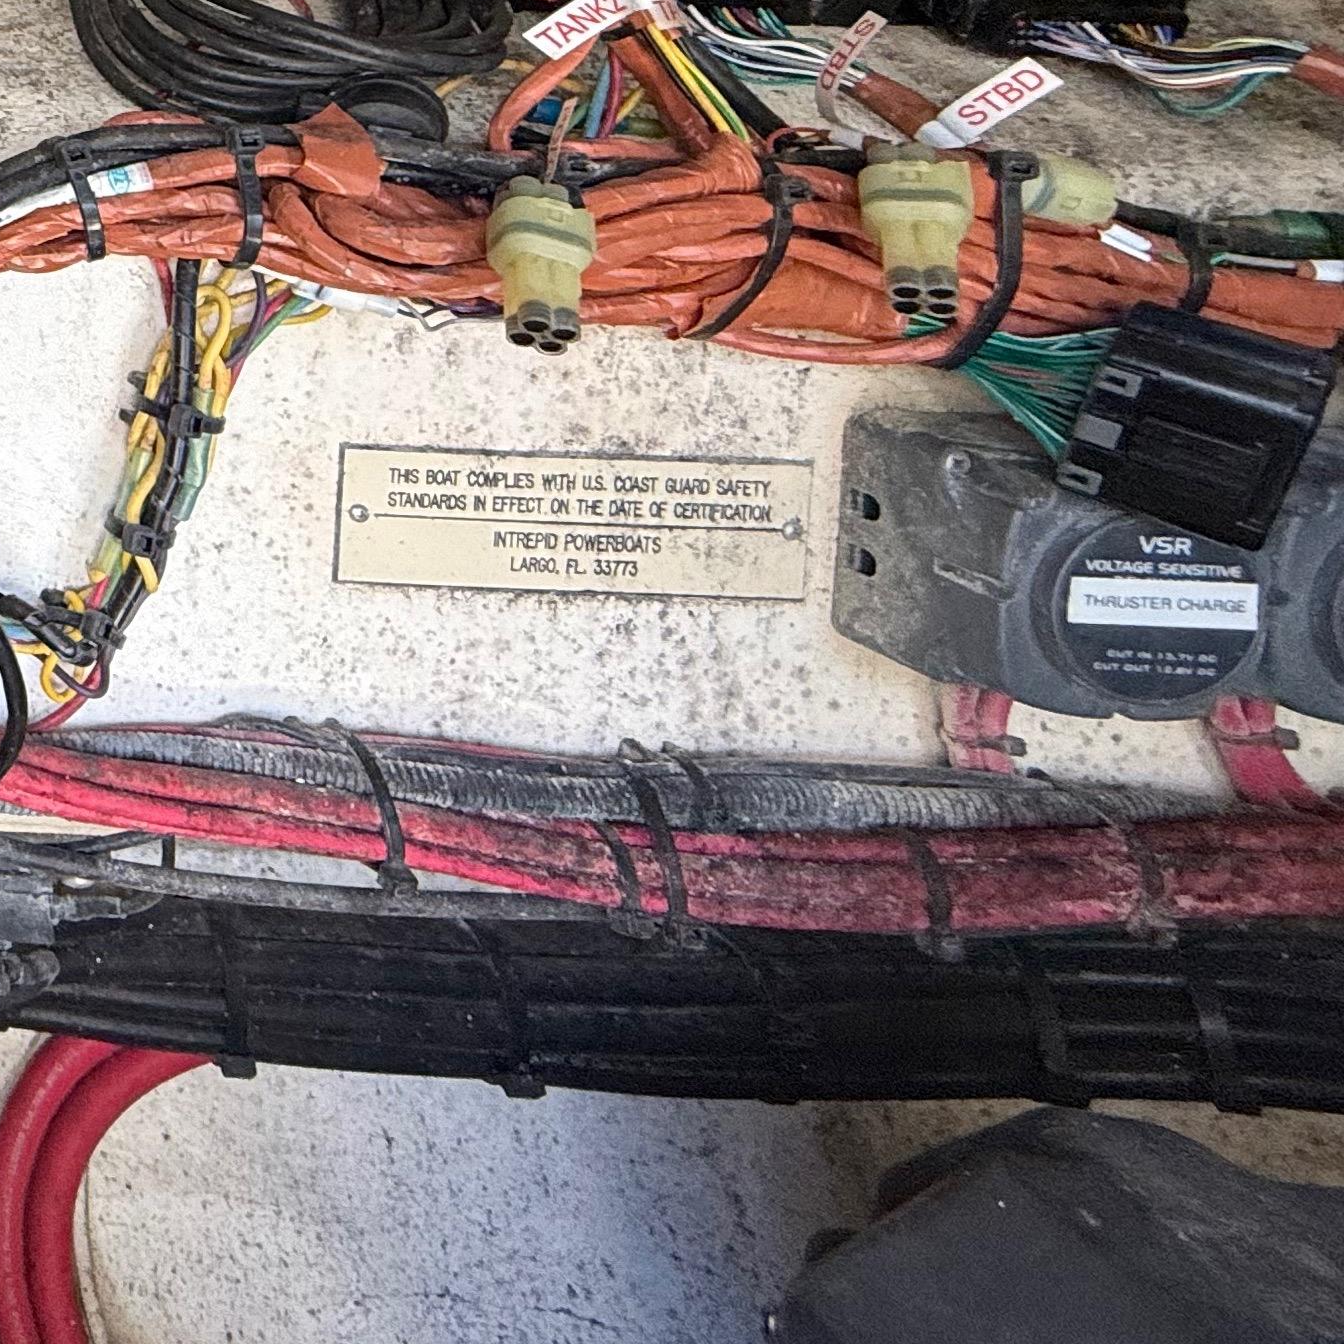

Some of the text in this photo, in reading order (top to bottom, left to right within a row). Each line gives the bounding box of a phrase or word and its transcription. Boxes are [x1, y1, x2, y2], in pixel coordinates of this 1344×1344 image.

[820, 18, 876, 91] STBD
[958, 69, 1045, 126] STBD
[389, 467, 771, 498] THIS BOAT COMPLIES WITH U.S. COAST GUARD SAFETY
[387, 492, 466, 511] STANDARDS
[474, 495, 486, 511] IN
[551, 498, 569, 515] ON
[577, 499, 603, 517] THE
[609, 500, 643, 518] DATE
[649, 502, 667, 519] OF
[674, 503, 772, 523] CERTIFICATION
[493, 531, 661, 554] INTREPID POWERBOATS
[1139, 535, 1193, 556] VSR
[511, 557, 559, 575] LARGO,
[593, 560, 638, 577] 33773
[1085, 559, 1242, 578] VOLTAGE SENSITIVE
[1084, 593, 1247, 613] THRUSTER CHARGE
